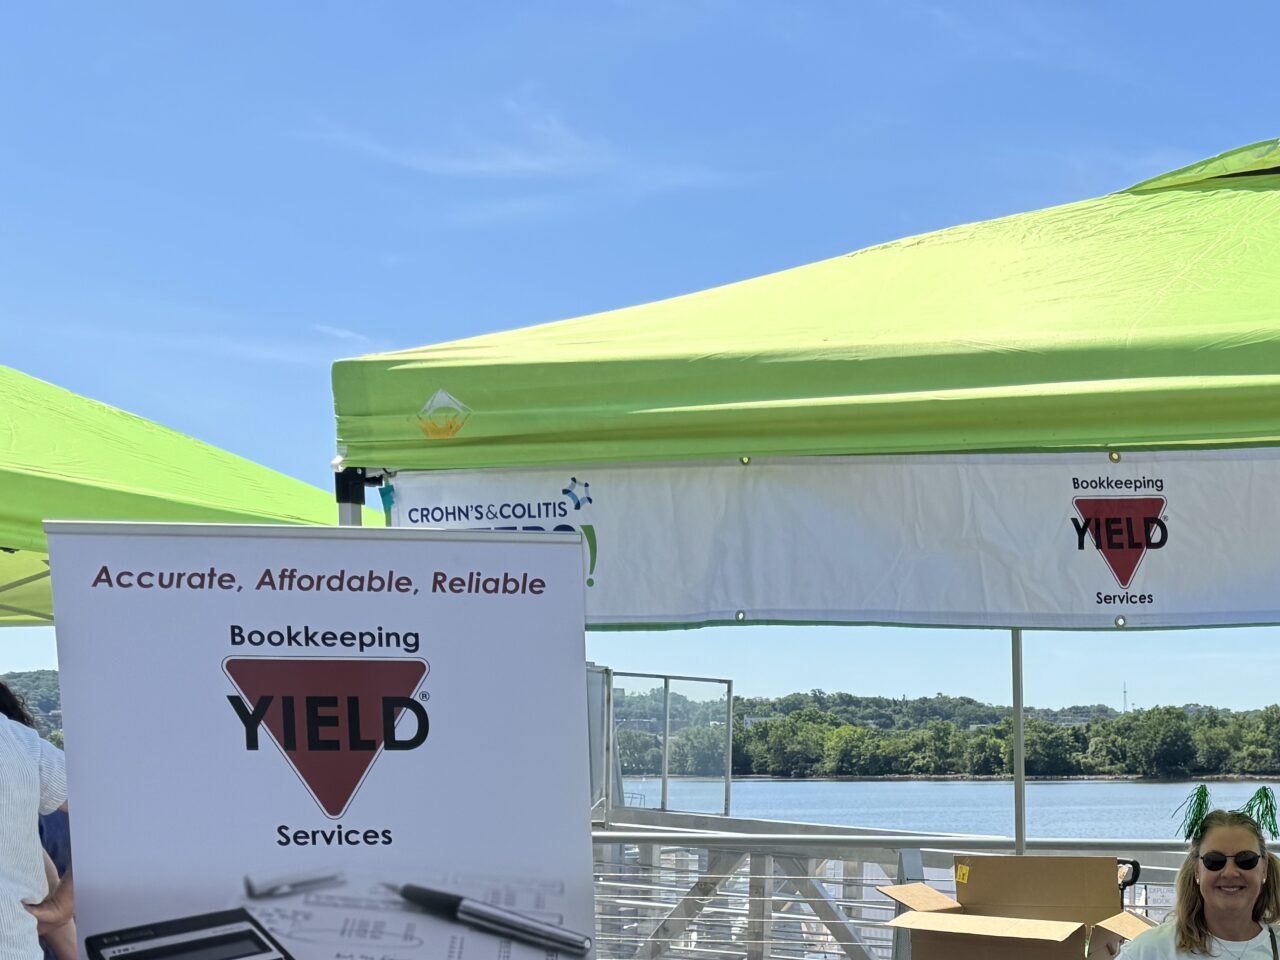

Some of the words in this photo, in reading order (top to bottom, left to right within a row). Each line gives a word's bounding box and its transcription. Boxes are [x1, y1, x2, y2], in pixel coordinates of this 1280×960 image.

[1072, 476, 1164, 492] Bookkeeping
[1070, 517, 1168, 550] YIELD
[92, 566, 243, 593] Accurate,
[256, 568, 419, 596] Affordable,
[431, 571, 546, 595] Reliable
[1096, 591, 1153, 604] Services
[230, 625, 420, 653] Bookkeeping
[276, 825, 393, 846] Services
